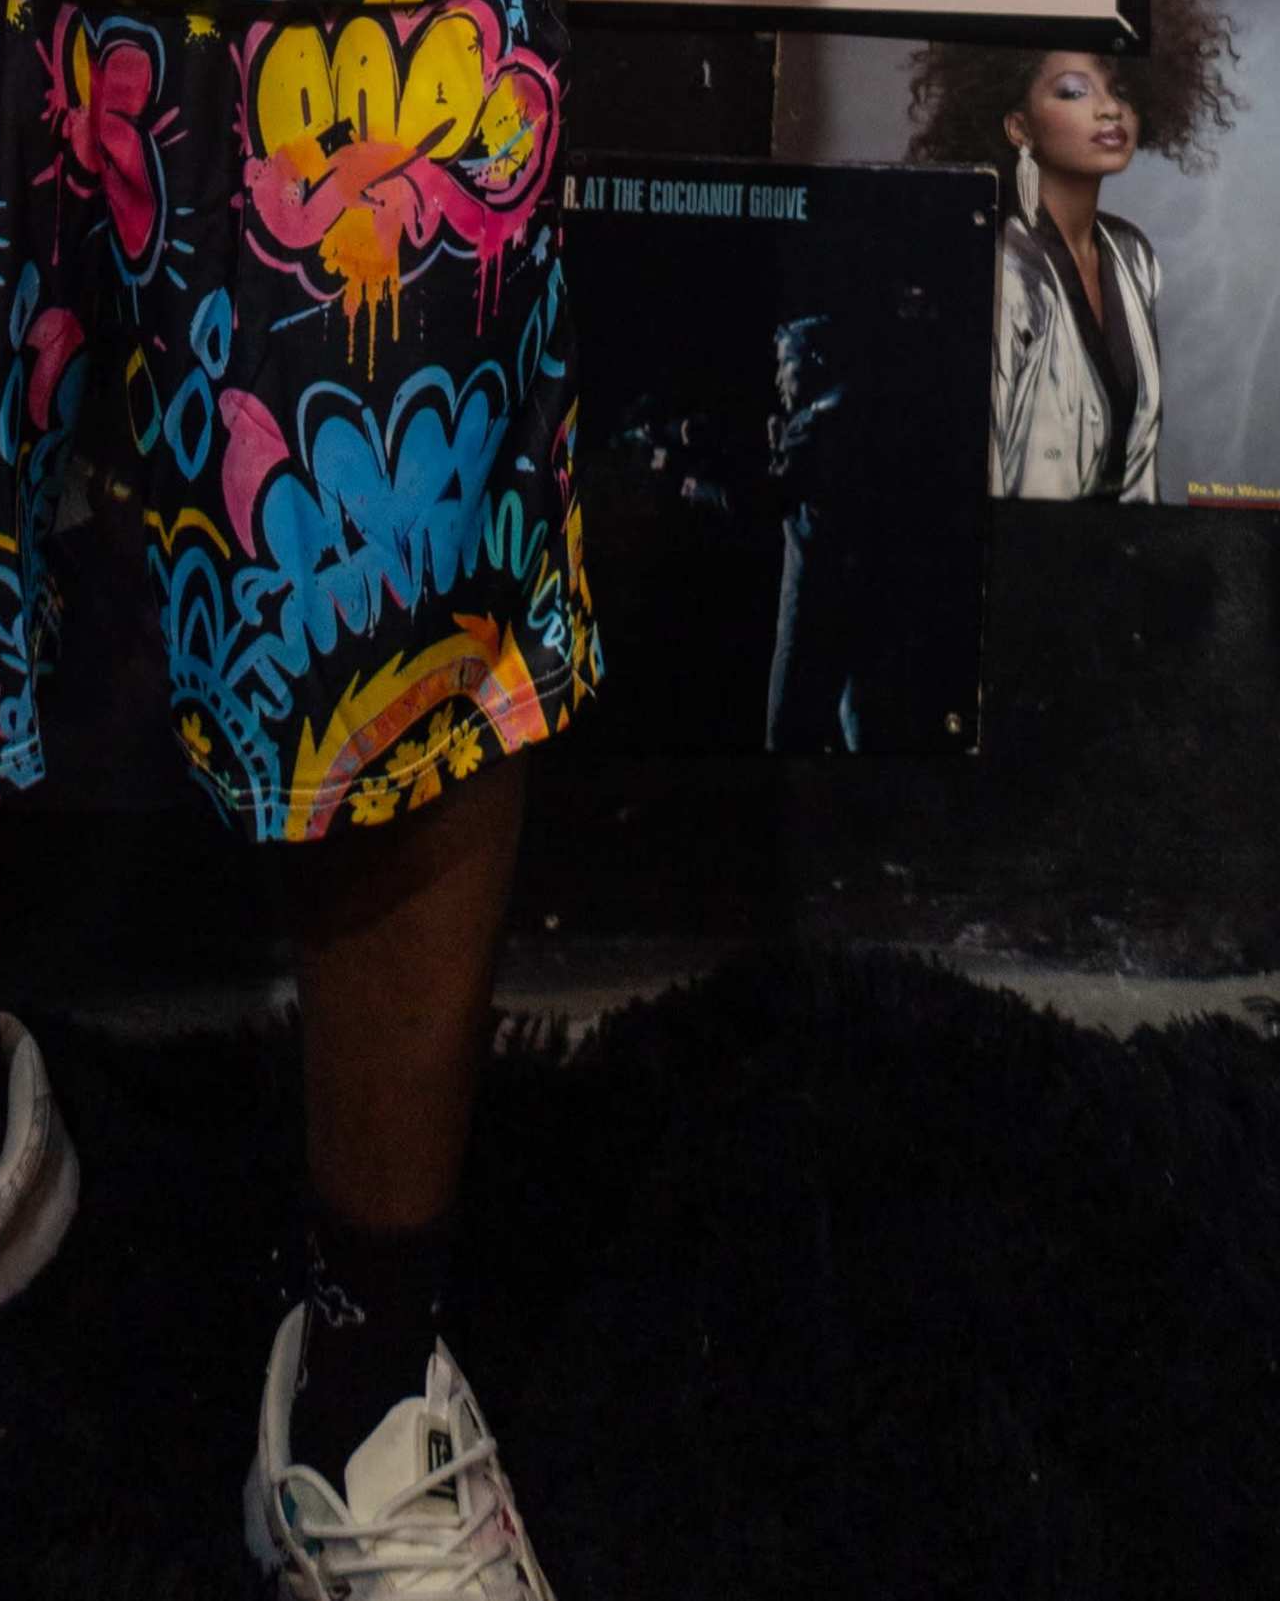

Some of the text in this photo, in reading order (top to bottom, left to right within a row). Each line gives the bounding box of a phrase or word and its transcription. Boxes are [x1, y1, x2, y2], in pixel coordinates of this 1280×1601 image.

[583, 176, 609, 210] AT
[612, 178, 645, 213] THE
[649, 180, 746, 219] COCOANUT
[749, 184, 809, 222] GROVE
